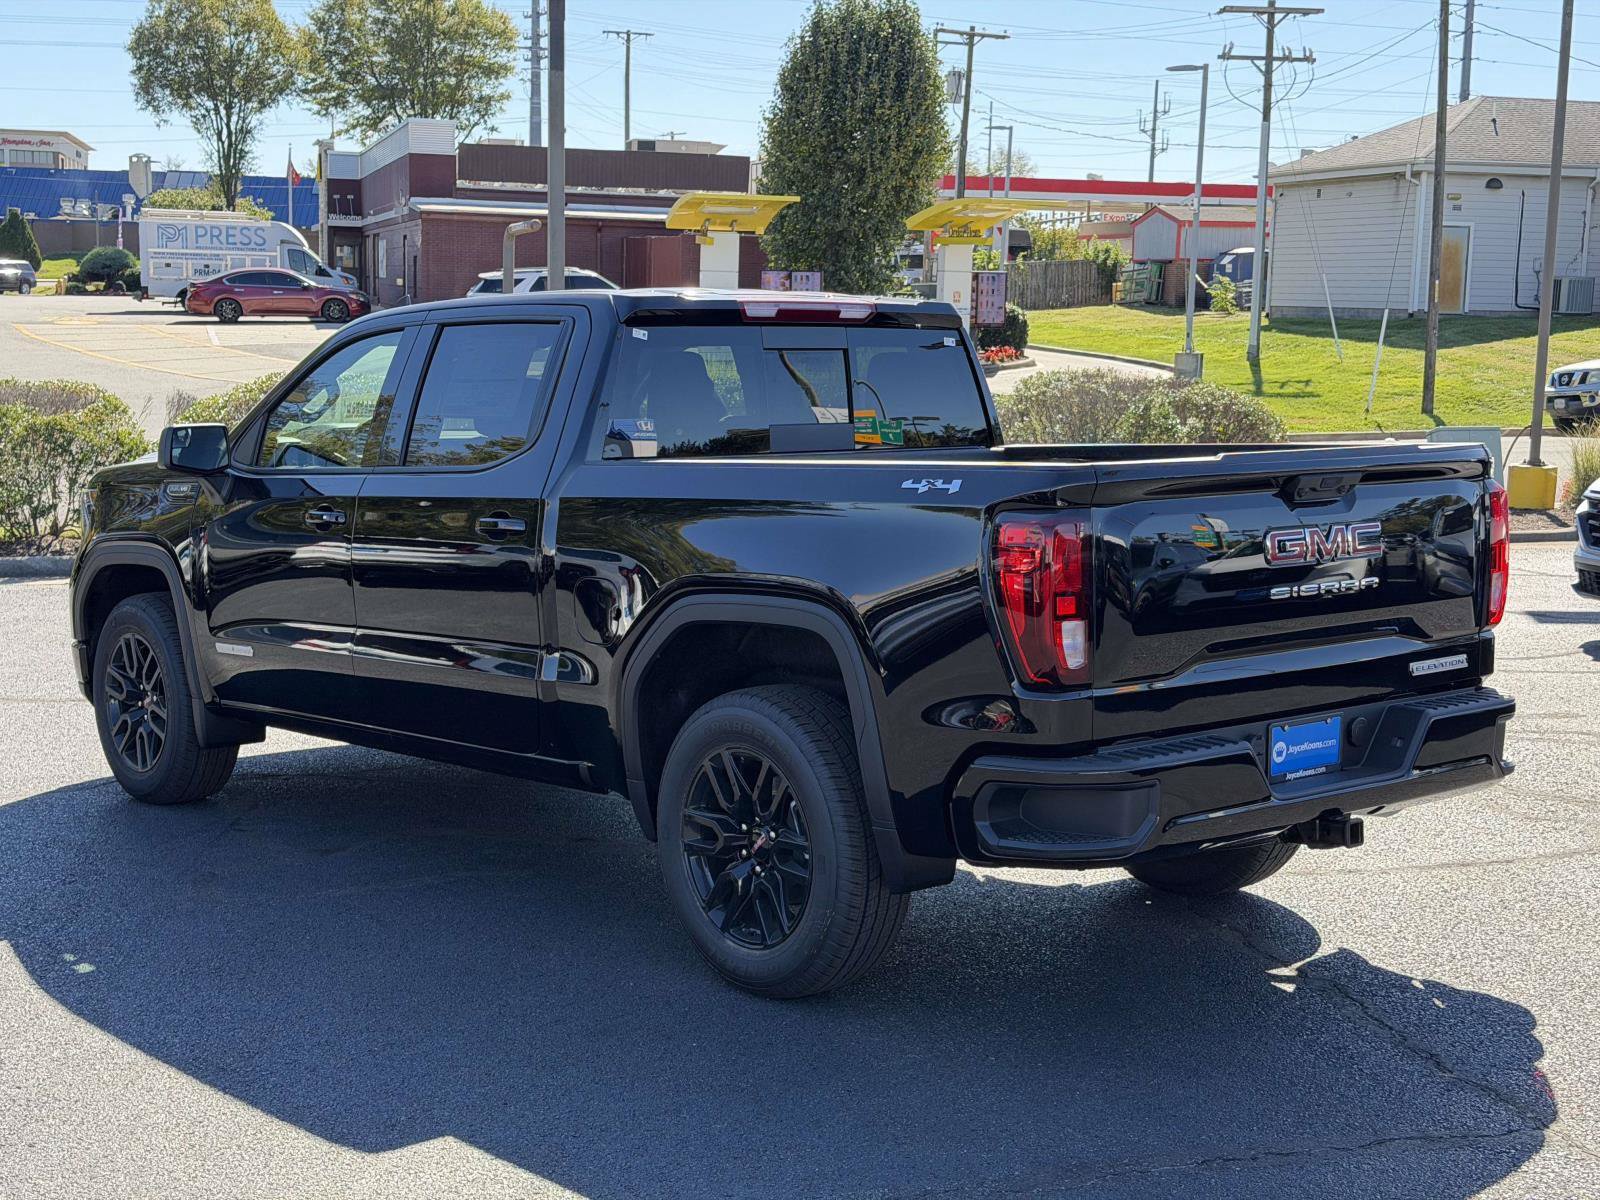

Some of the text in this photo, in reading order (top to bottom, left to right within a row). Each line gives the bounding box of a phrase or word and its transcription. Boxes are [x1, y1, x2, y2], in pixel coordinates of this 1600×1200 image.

[328, 213, 362, 221] Welcome
[1103, 213, 1126, 222] Exxon
[194, 224, 267, 247] PRESS
[1263, 521, 1384, 568] GMC
[1270, 576, 1380, 600] SIERRA
[1415, 658, 1464, 672] ELEVATION
[1287, 738, 1337, 754] JoyceKoons.com
[1285, 766, 1327, 780] JoyceKoons.com
